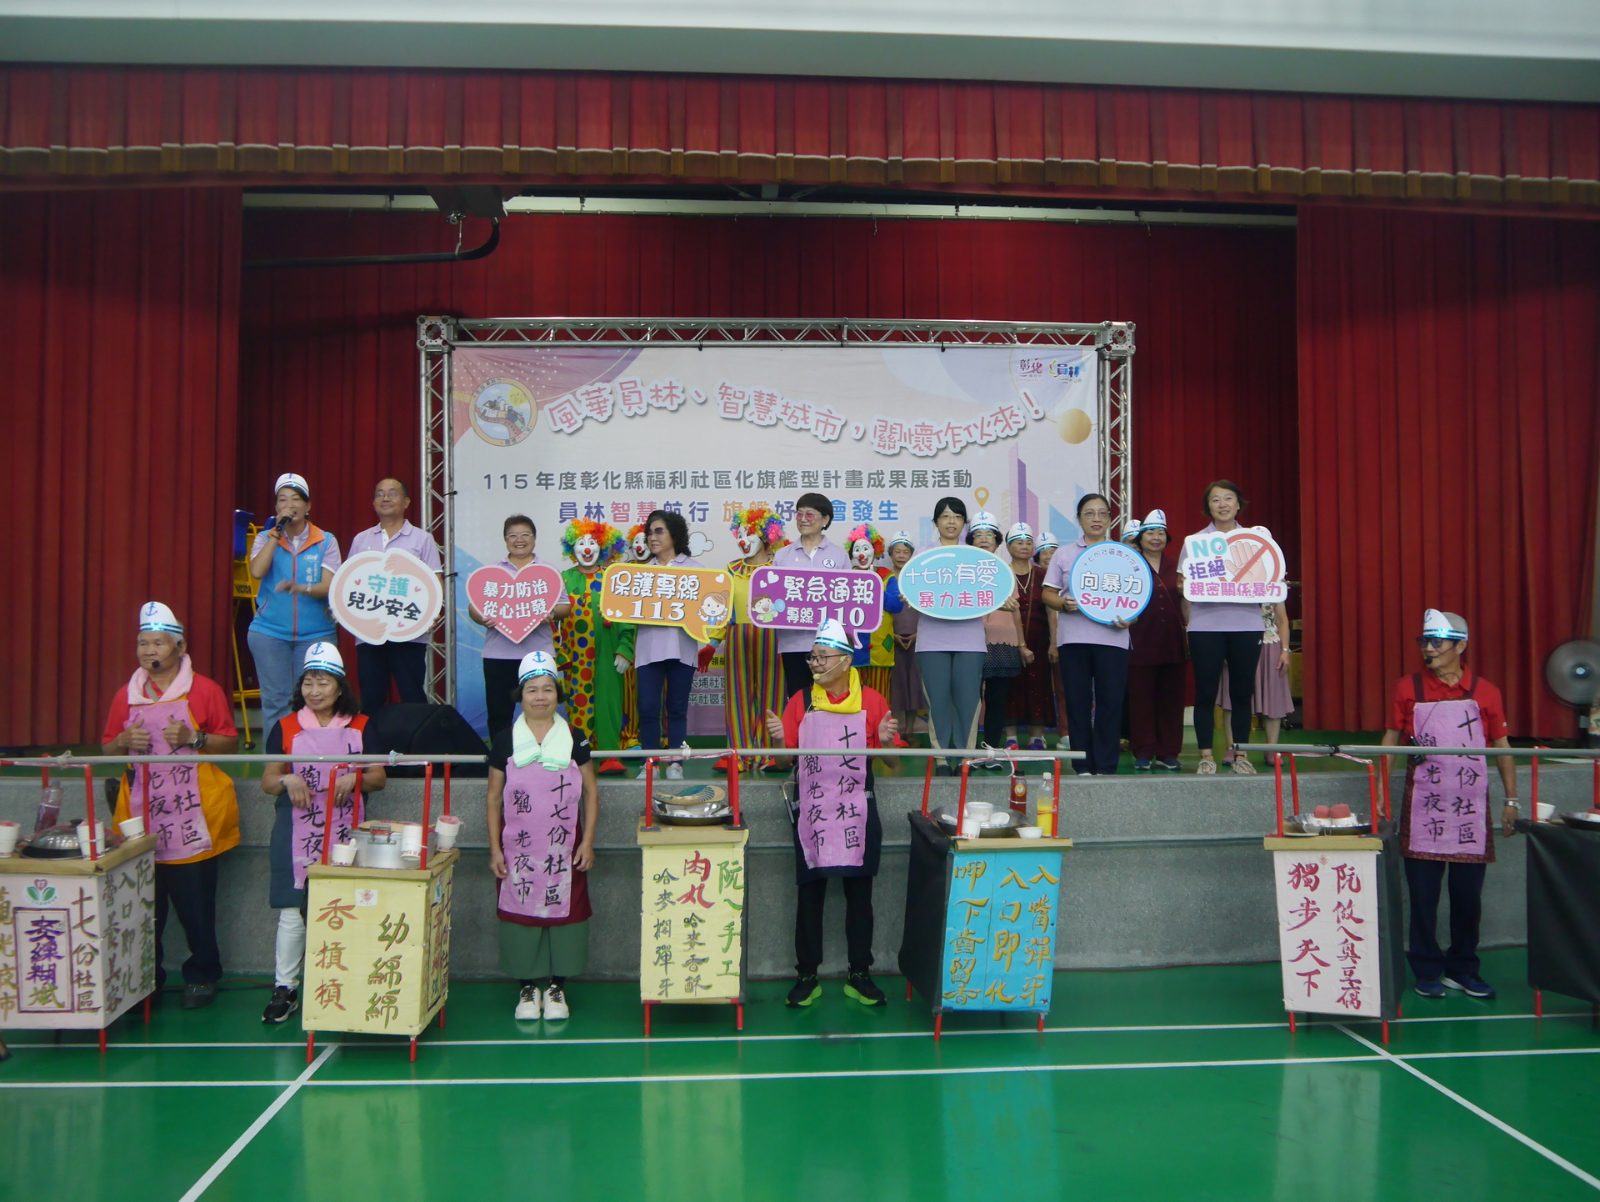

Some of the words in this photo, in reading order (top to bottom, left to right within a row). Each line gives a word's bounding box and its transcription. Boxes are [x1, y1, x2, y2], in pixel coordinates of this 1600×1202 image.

[483, 468, 973, 491] 115年度彰化縣福利社區化旗艦型計畫成果展活動
[1191, 537, 1228, 558] NO
[905, 558, 999, 588] 十七份有愛
[1188, 559, 1227, 580] 拒絕
[367, 574, 411, 598] 守護
[482, 578, 549, 600] 暴力防治
[610, 569, 701, 601] 保護專線
[783, 575, 875, 604] 緊急通報
[1080, 571, 1143, 595] 向暴力
[1190, 582, 1281, 597] 親密關係暴力
[347, 590, 422, 621] 兒少安全
[482, 599, 549, 620] 從心出發
[629, 600, 687, 622] 113
[919, 590, 994, 608] 暴力走開
[1080, 592, 1111, 610] Say
[1115, 595, 1139, 610] No
[835, 725, 862, 849] 十七份社區
[803, 754, 828, 857] 觀光夜市
[512, 789, 535, 905] 觀光夜市
[543, 774, 572, 907] 十七份社區
[984, 867, 1031, 1004] 入口即化
[1286, 862, 1332, 998] 獨步天下
